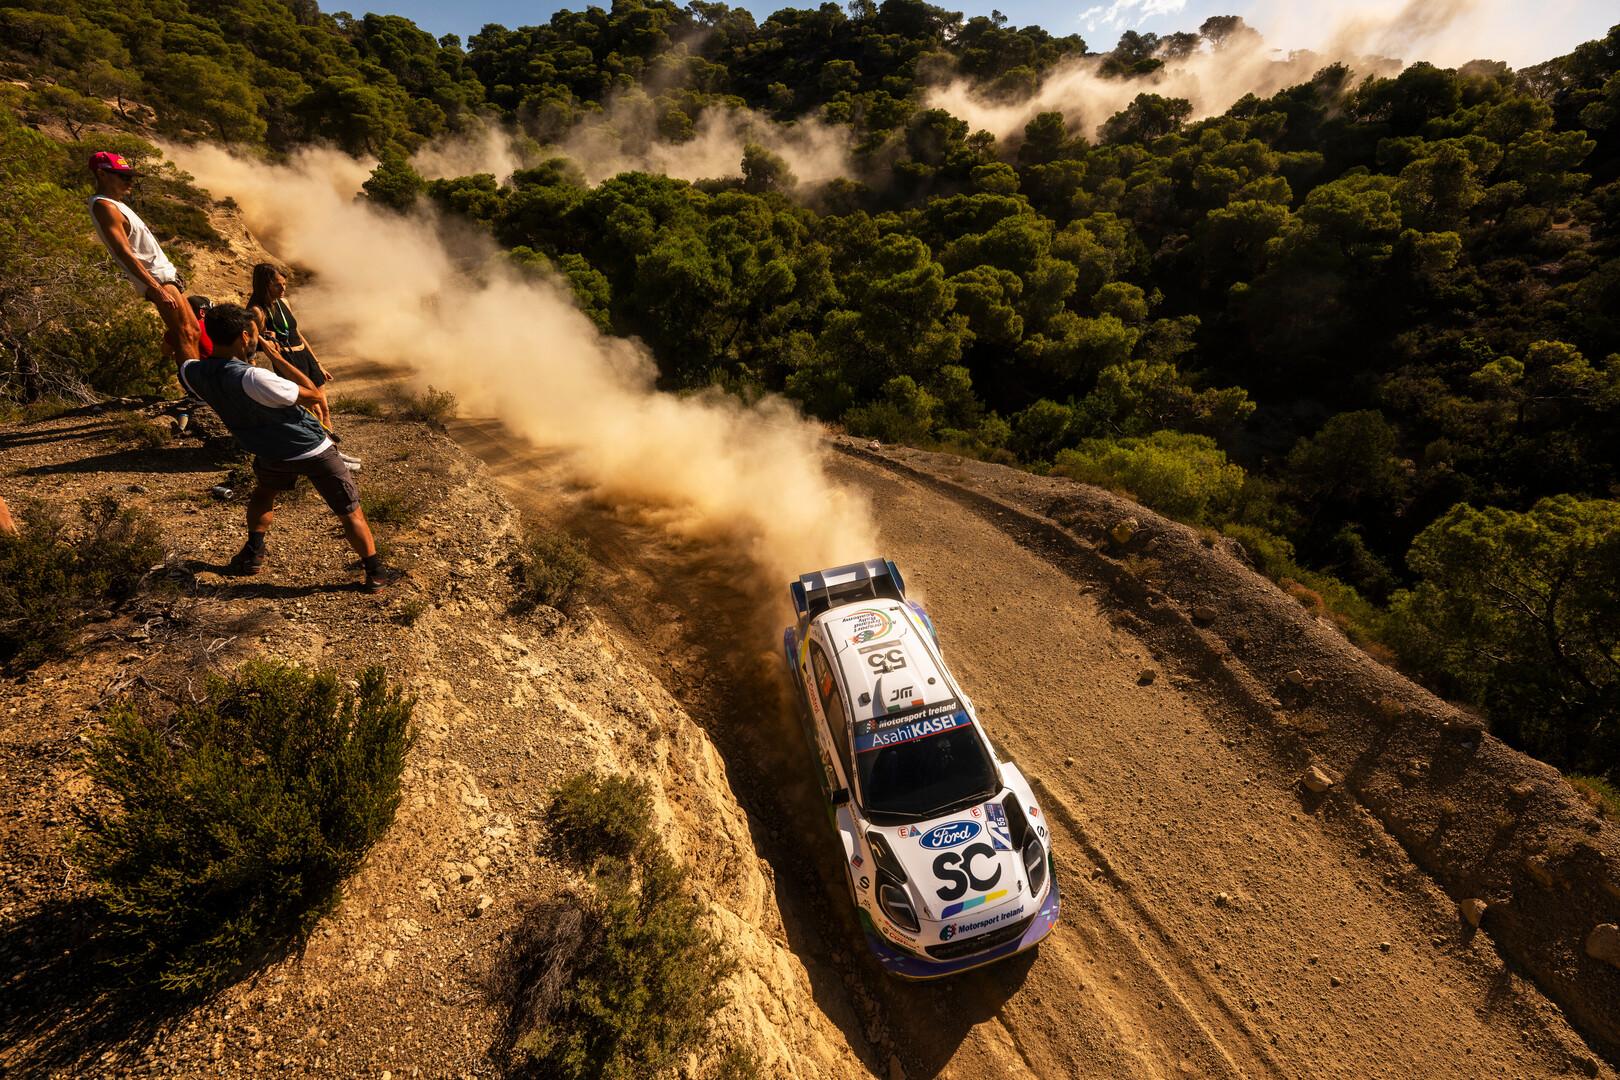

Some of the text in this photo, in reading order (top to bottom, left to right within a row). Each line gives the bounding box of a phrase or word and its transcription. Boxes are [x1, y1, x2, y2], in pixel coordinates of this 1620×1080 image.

[867, 649, 907, 675] 55
[928, 701, 957, 716] Ireland
[997, 817, 1006, 826] 55
[932, 824, 971, 847] Ford
[932, 842, 1002, 902] SC
[958, 905, 1024, 933] Motorsport Ireland
